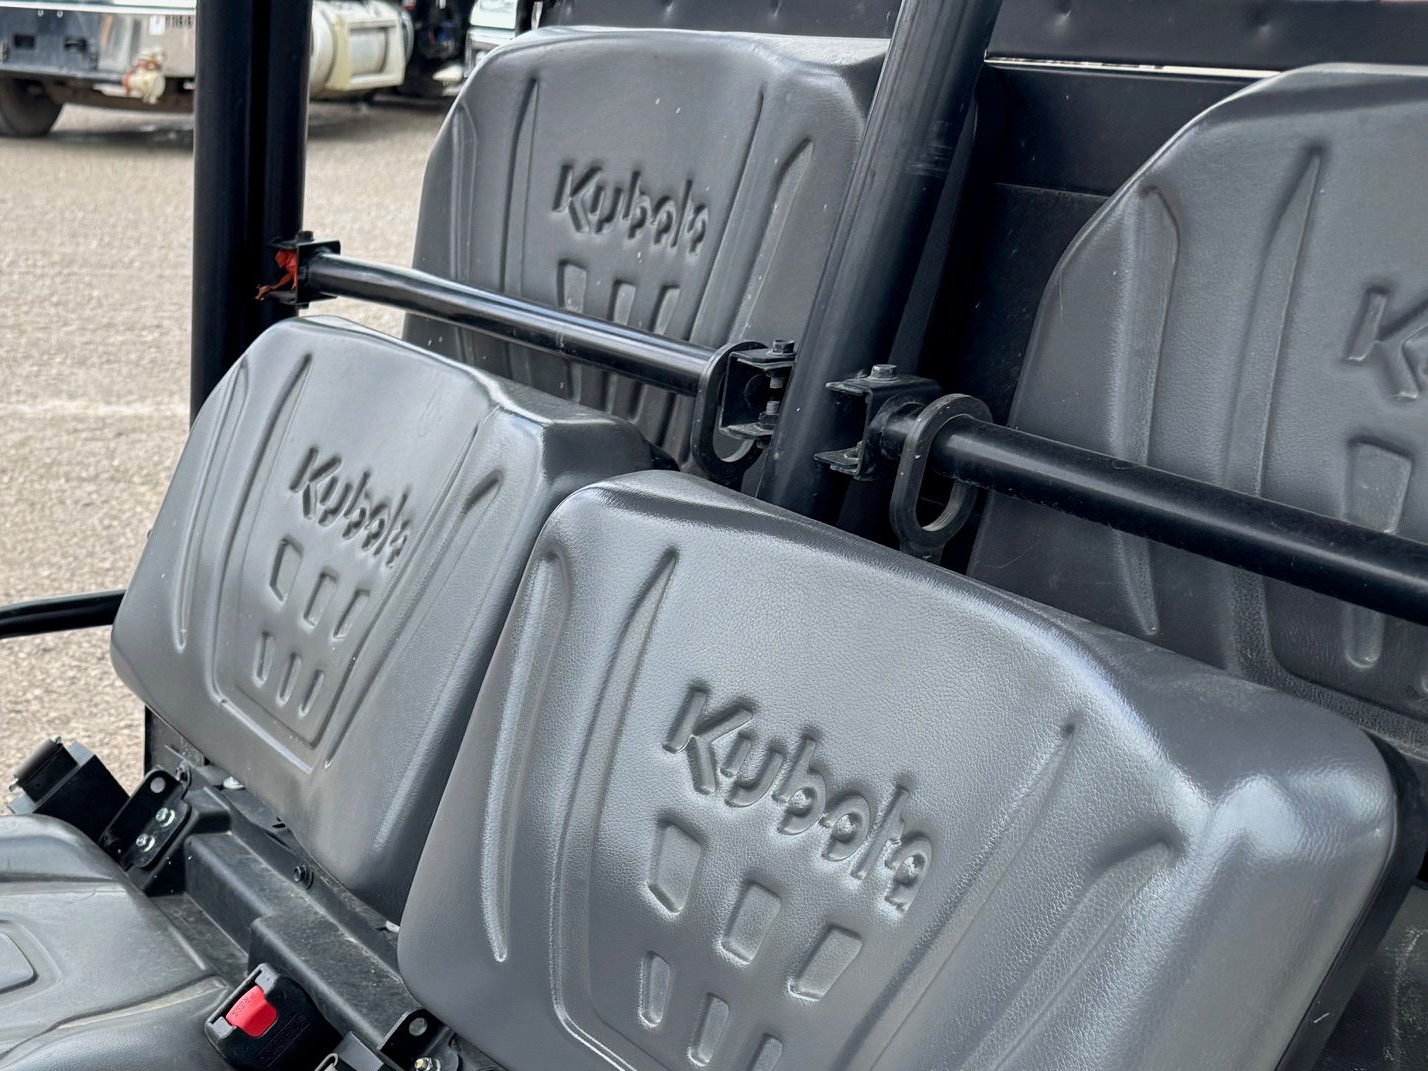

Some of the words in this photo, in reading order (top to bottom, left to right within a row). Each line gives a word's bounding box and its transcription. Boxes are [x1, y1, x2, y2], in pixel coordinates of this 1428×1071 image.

[551, 162, 709, 257] Kubota
[288, 446, 410, 570] Kubota
[662, 678, 933, 914] Kubota
